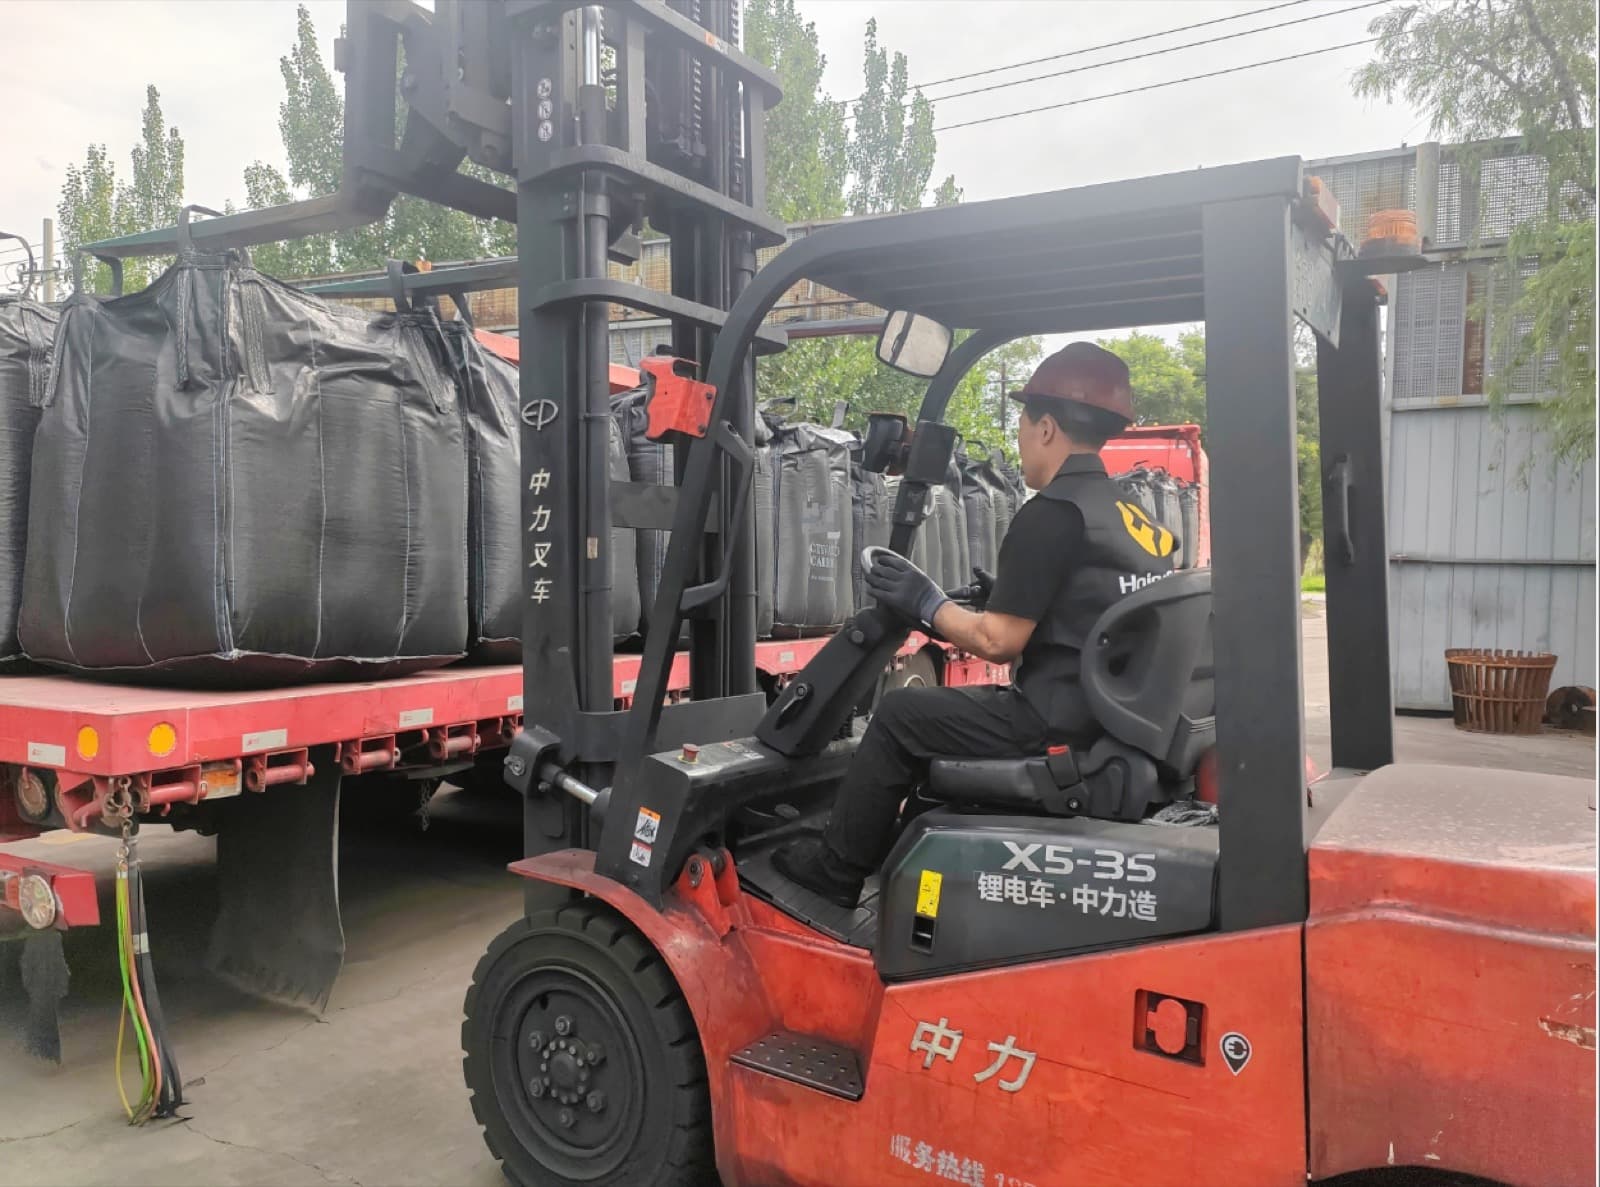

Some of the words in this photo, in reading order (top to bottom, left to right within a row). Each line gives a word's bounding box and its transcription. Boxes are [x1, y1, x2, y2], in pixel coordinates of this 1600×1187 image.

[528, 467, 553, 605] 中力叉车
[1001, 841, 1157, 883] X5-35
[977, 872, 1158, 922] 锂电车·中力造
[910, 1017, 1038, 1093] 中力
[889, 1134, 985, 1187] 服务热线
